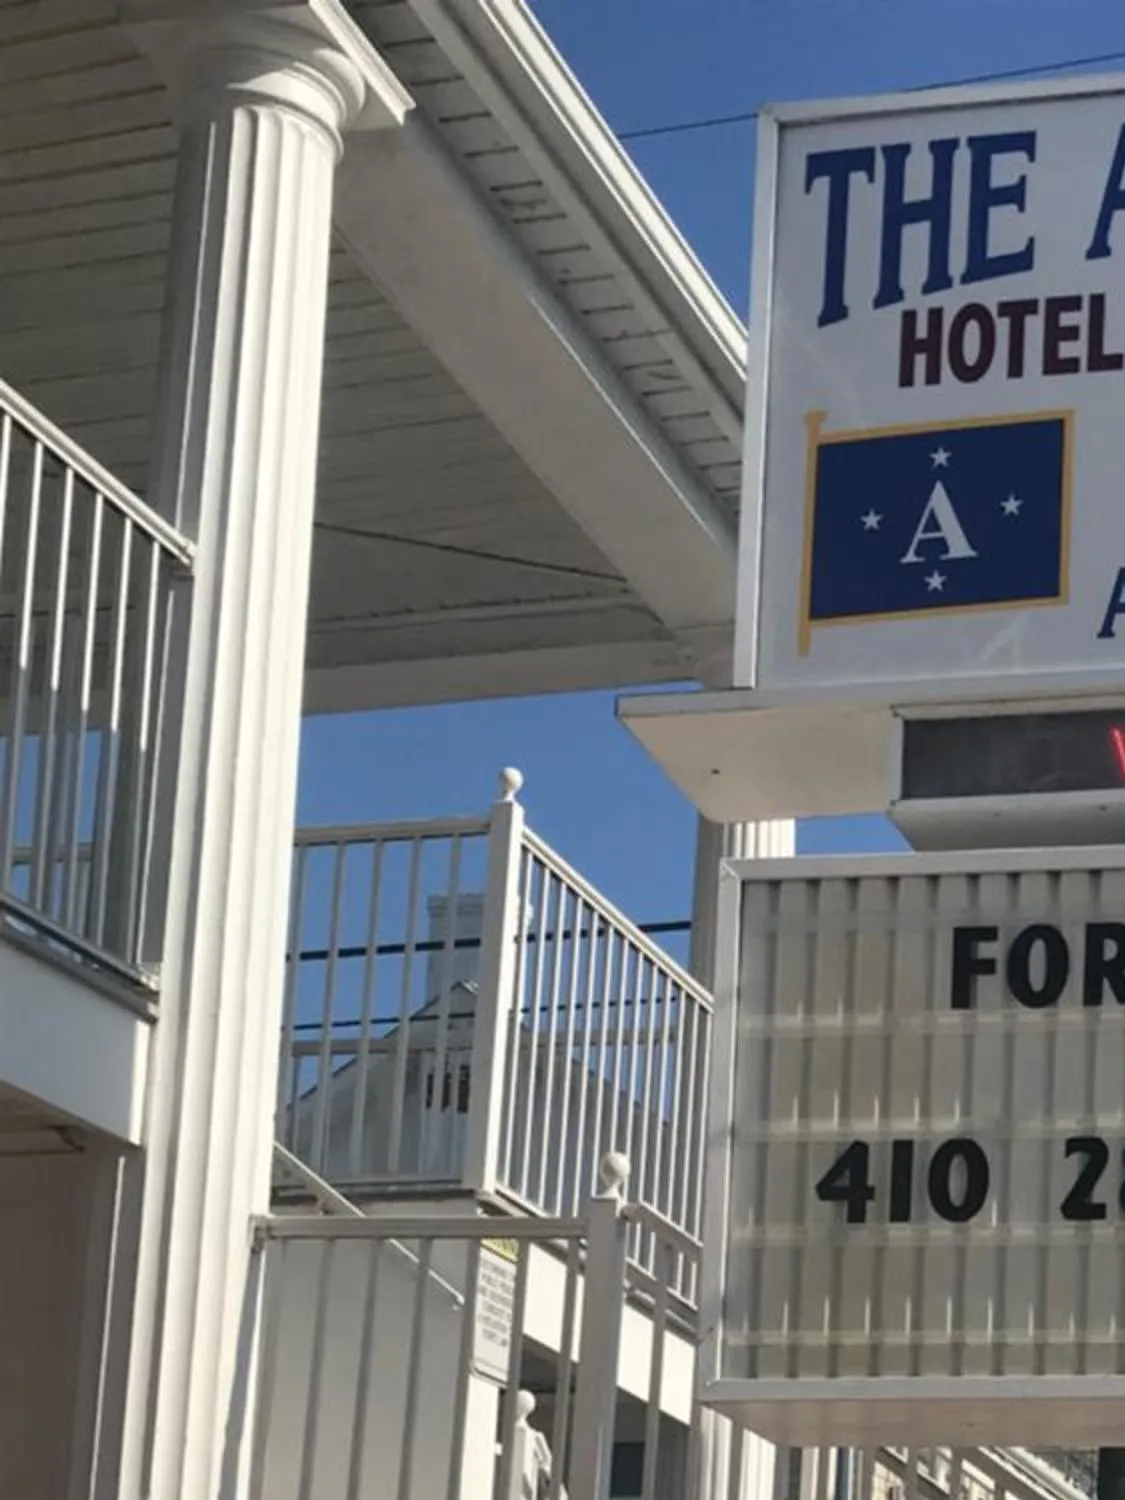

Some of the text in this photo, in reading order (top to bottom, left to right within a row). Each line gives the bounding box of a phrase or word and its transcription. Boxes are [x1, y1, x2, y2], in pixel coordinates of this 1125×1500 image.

[805, 130, 1038, 328] THE
[898, 292, 1124, 389] HOTEL
[900, 479, 978, 566] A
[815, 1137, 991, 1225] 410
